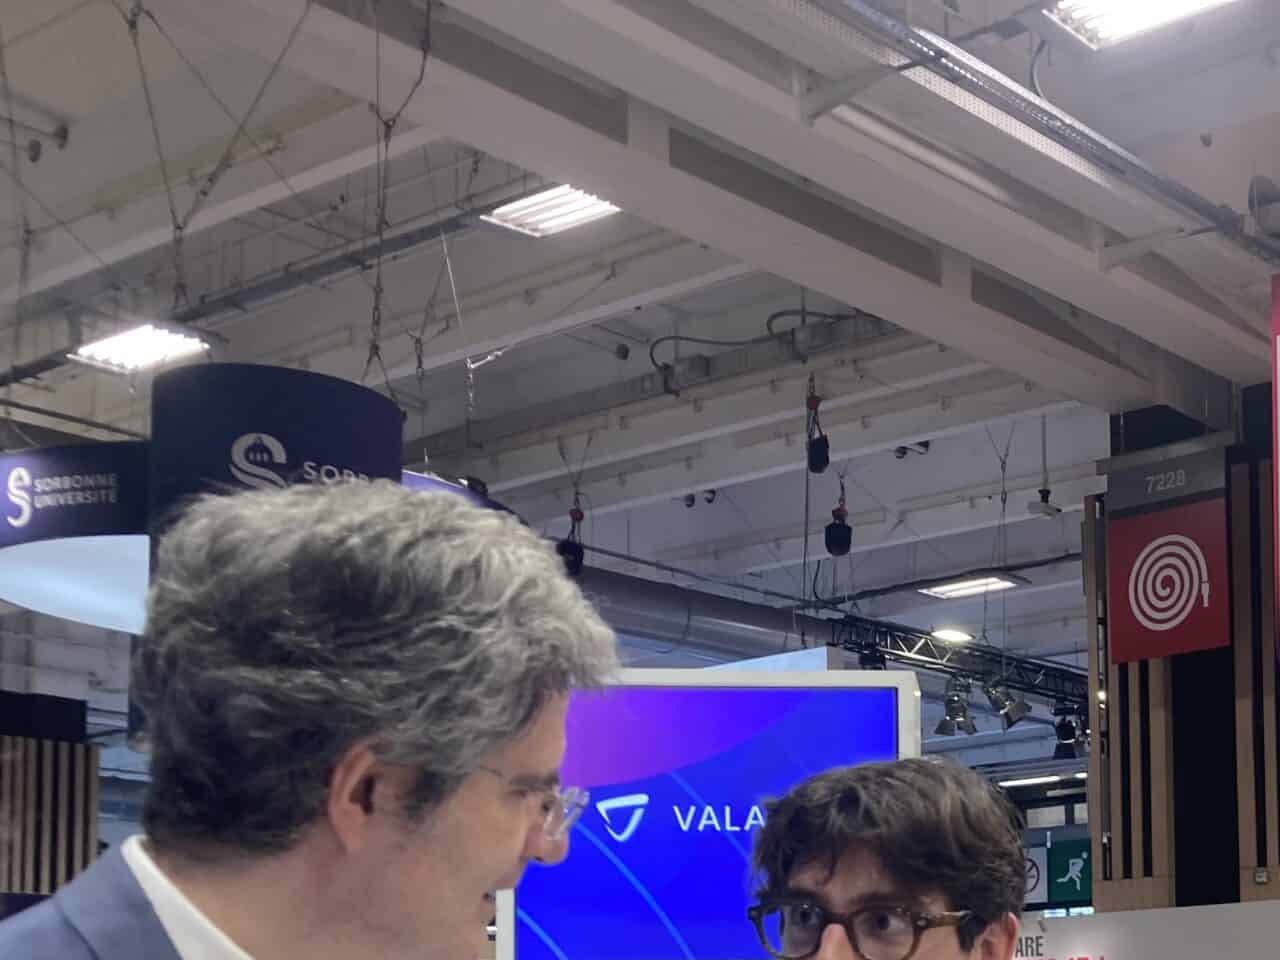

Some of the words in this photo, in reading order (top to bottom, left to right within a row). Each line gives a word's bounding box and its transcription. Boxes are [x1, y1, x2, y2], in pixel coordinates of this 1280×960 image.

[33, 473, 119, 492] SORBONNE
[303, 461, 369, 483] SOR
[672, 805, 766, 831] VALA
[1015, 935, 1044, 958] ARE
